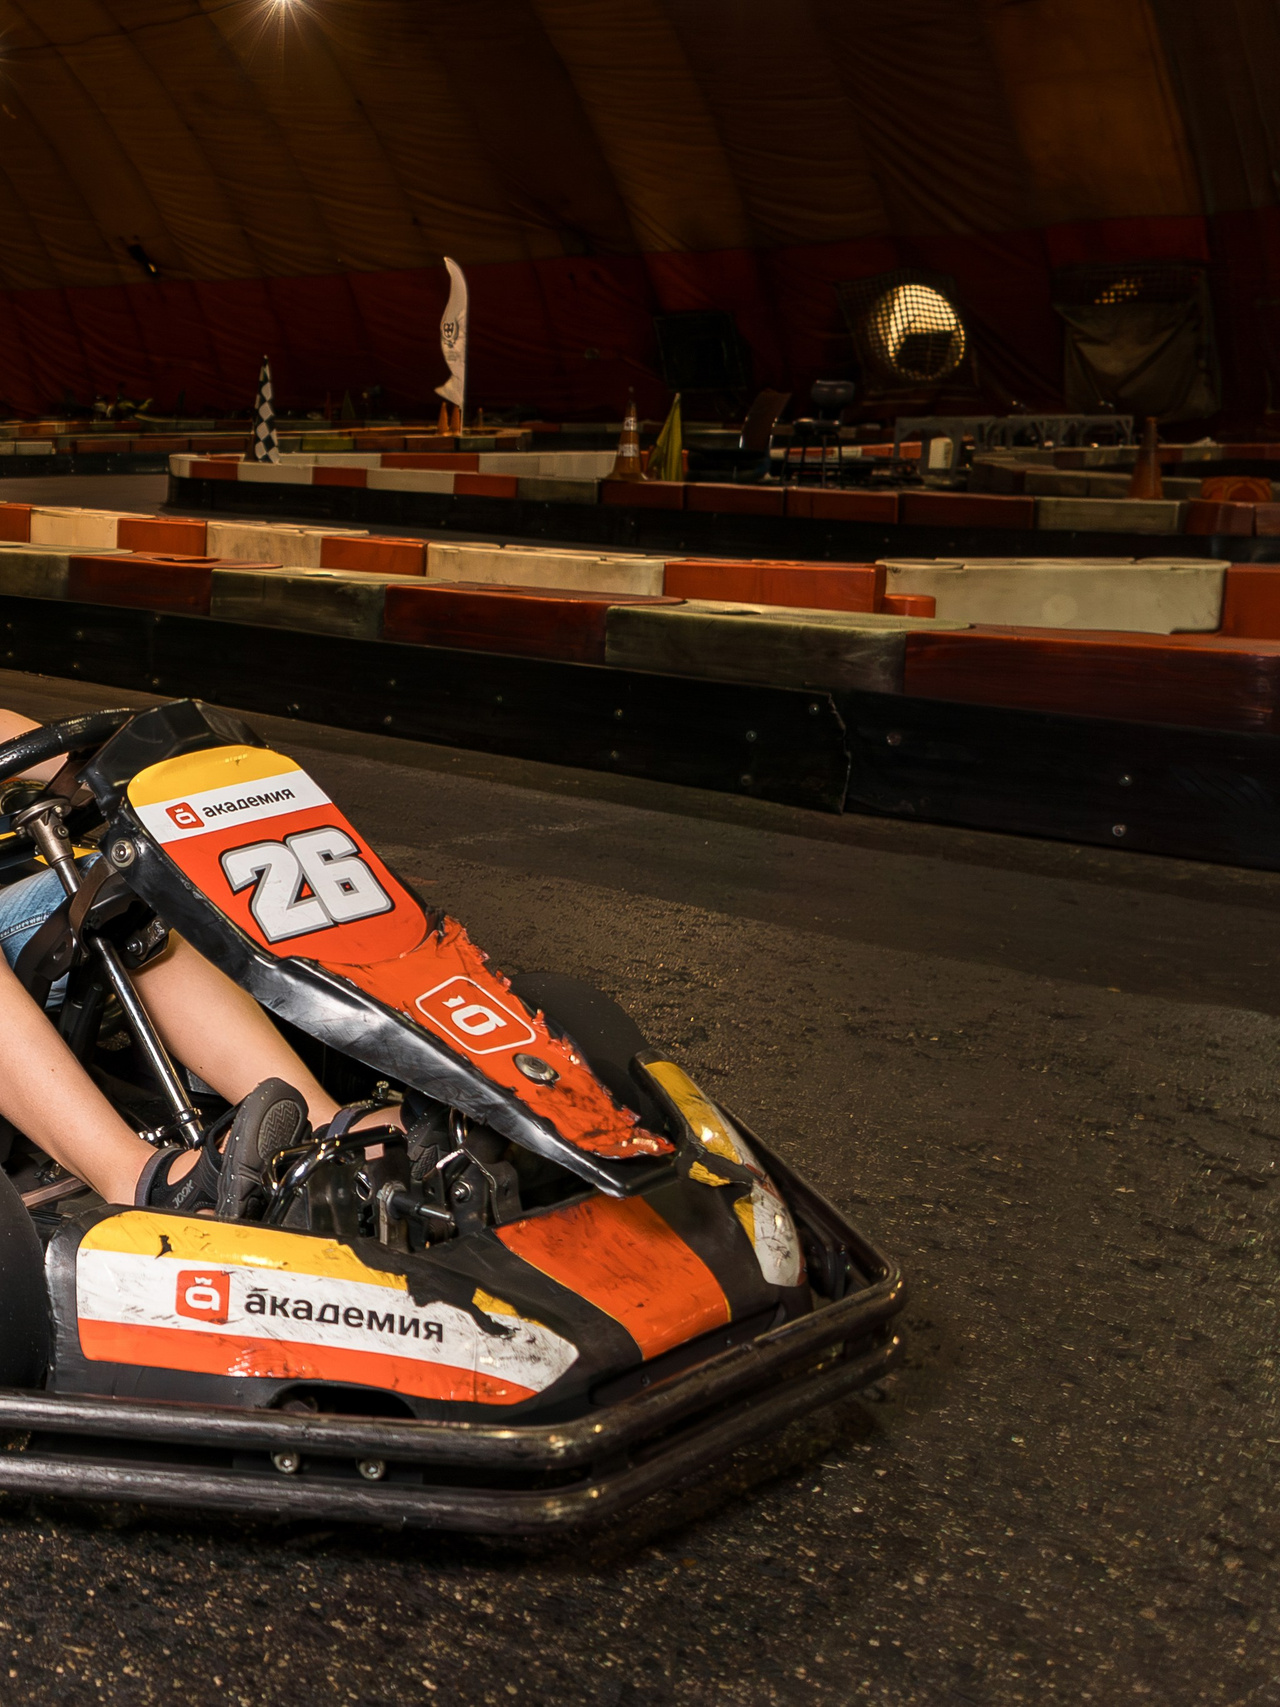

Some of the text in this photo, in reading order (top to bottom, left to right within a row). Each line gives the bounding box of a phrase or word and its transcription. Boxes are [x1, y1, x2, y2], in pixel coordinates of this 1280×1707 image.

[202, 788, 296, 818] академия
[218, 824, 396, 945] 26
[244, 1292, 445, 1343] академия
